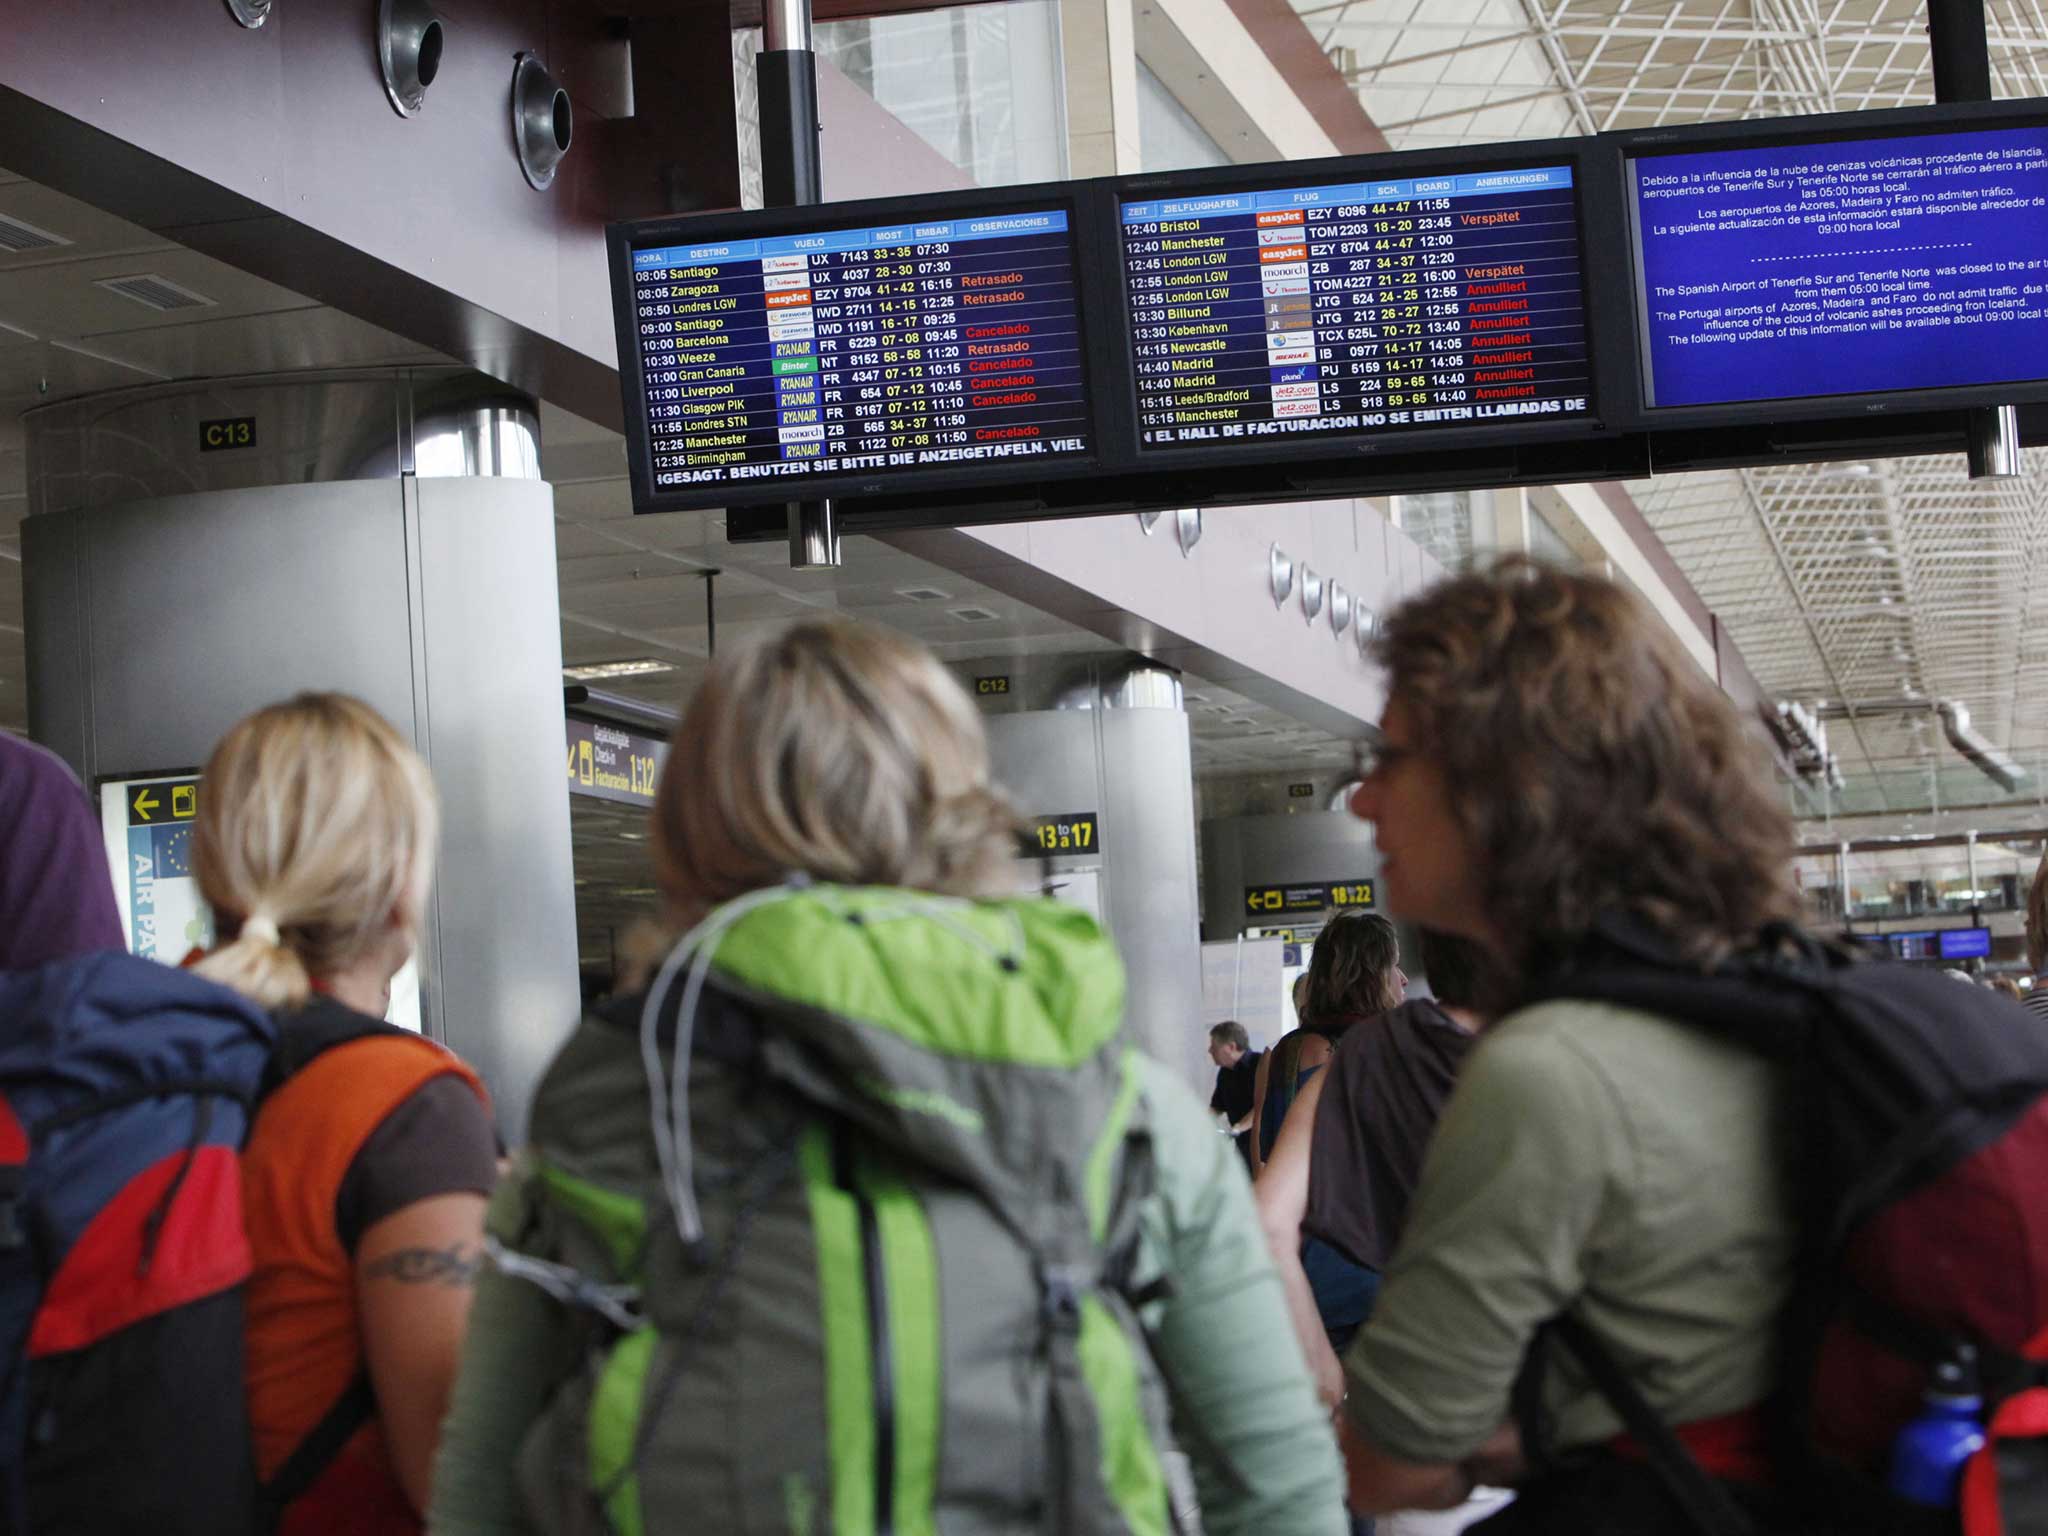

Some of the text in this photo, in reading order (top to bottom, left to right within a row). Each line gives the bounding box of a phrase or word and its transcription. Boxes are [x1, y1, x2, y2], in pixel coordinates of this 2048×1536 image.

[1128, 173, 1549, 217] ZEIT ZIELFLUGHAFEN FLUG SCH. BOARD ANMERKUNGEN
[1698, 209, 1718, 219] Los
[1719, 204, 1782, 218] aeropuertos
[1783, 202, 1798, 212] de
[1841, 196, 1883, 208] Madeira
[1885, 196, 1893, 207] y
[1894, 193, 1919, 204] Faro
[1921, 193, 1935, 202] no
[1937, 189, 1979, 201] admiten
[1801, 181, 1910, 199] las 05:00 horas local.
[635, 217, 1049, 263] HORA DESTINO VUELO MOST EMBAR OBSERVACIONES
[1125, 219, 1200, 235] 12:40 Bristol
[1126, 211, 1520, 254] 12:40 Manchester Verspätet
[1817, 219, 1901, 235] 09:00 hora local
[635, 266, 719, 282] 08:05 Santiago
[1128, 252, 1227, 271] 12:45 London LGW
[1130, 270, 1228, 289] 12:55 London LGW
[637, 284, 720, 300] 08:05 Zaragoza
[639, 304, 671, 317] 08:50
[672, 301, 712, 314] Londres
[713, 297, 737, 311] LGW
[961, 272, 1023, 287] Retrasado
[1131, 264, 1525, 306] 12:55 London LGW Verspätet
[1132, 280, 1527, 323] 13:30 Billund Annulliert
[1794, 288, 1819, 298] from
[1820, 287, 1847, 297] them
[1849, 282, 1879, 295] 05:00
[1881, 281, 1906, 292] local
[640, 290, 1025, 335] 09:00 Santiago Retrasado
[1134, 298, 1529, 339] 13:30 København Annulliert
[642, 335, 729, 351] 10:00 Barcelona
[644, 354, 676, 367] 10:30
[677, 352, 716, 365] Weeze
[965, 323, 1030, 339] Cancelado
[1135, 315, 1530, 356] 14:15 Newcastle Annulliert
[1137, 360, 1170, 374] 14:40
[1171, 357, 1214, 371] Madrid
[1471, 333, 1531, 347] Annulliert
[646, 371, 678, 384] 11:00
[678, 370, 704, 381] Gran
[705, 365, 745, 379] Canaria
[967, 340, 1030, 356] Retrasado
[647, 357, 1033, 401] 11:00 Liverpool Cancelado
[1138, 377, 1171, 391] 14:40
[1173, 374, 1216, 388] Madrid
[1472, 351, 1533, 365] Annulliert
[649, 374, 1035, 417] 11:30 Glasgow PIK Cancelado
[1140, 395, 1173, 409] 15:15
[1174, 389, 1250, 406] Leeds/Bradford
[1474, 367, 1534, 382] Annulliert
[1141, 385, 1535, 425] 15:15 Manchester Annulliert
[651, 391, 1037, 434] 11:55 Londres STN Cancelado
[1155, 398, 1586, 442] EL HALL DE FACTURACION NO SE EMITEN LLAMADAS DE
[207, 422, 250, 446] C13
[652, 438, 684, 452] 12:25
[685, 434, 747, 449] Manchester
[654, 425, 1040, 468] 12:35 Birmingham Cancelado
[729, 461, 810, 479] BENUTZEN
[813, 458, 838, 472] SIE
[841, 454, 886, 470] BITTE
[889, 452, 915, 466] DIE
[918, 441, 1048, 463] ANZEIGETAFELN.
[1050, 438, 1085, 452] VIEL
[979, 680, 1006, 692] C12
[1037, 822, 1092, 848] 13 to 17
[1060, 836, 1070, 848] a
[134, 853, 153, 905] AIR
[1331, 886, 1348, 905] 18
[1356, 884, 1371, 904] 22
